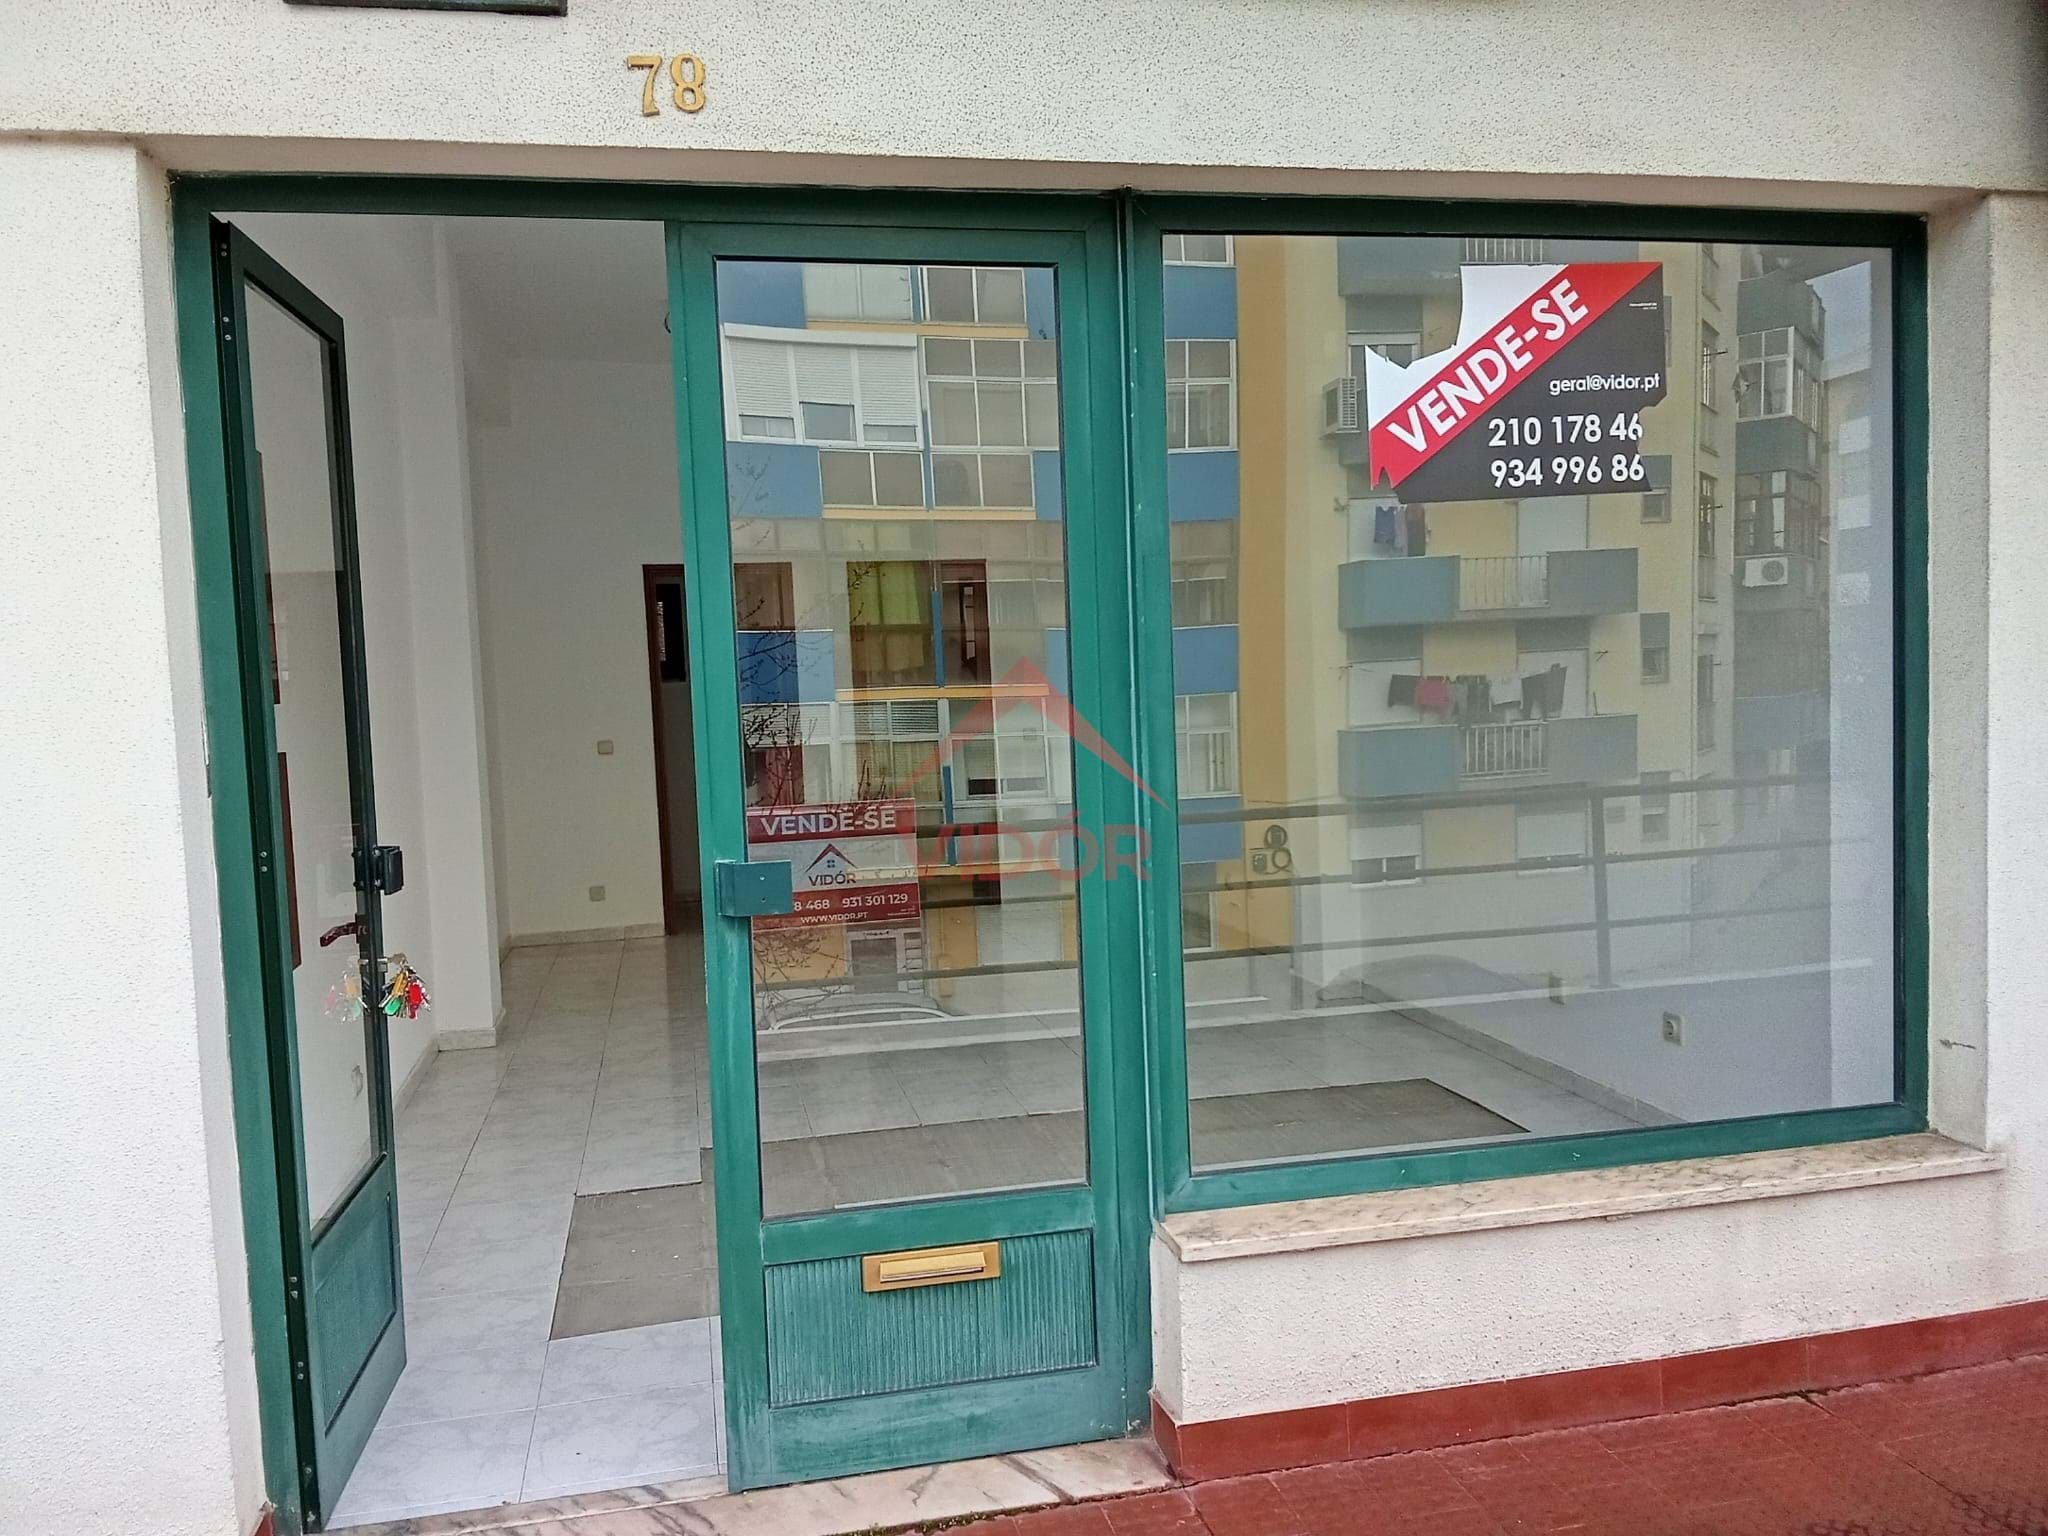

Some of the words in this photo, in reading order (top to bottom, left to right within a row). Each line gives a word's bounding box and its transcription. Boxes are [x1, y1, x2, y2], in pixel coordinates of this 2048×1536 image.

[627, 53, 706, 117] 78
[1386, 278, 1589, 453] VENDE-SE
[1549, 373, 1661, 396] geral@vidor.pt
[1488, 417, 1542, 447] 210
[1551, 414, 1602, 443] 178
[1490, 457, 1543, 488] 934
[1551, 454, 1602, 484] 996
[1611, 453, 1645, 482] 86
[760, 805, 897, 836] VENDE-SE
[806, 899, 831, 911] 468
[842, 896, 862, 908] 931
[865, 894, 885, 906] 301
[888, 892, 908, 904] 129
